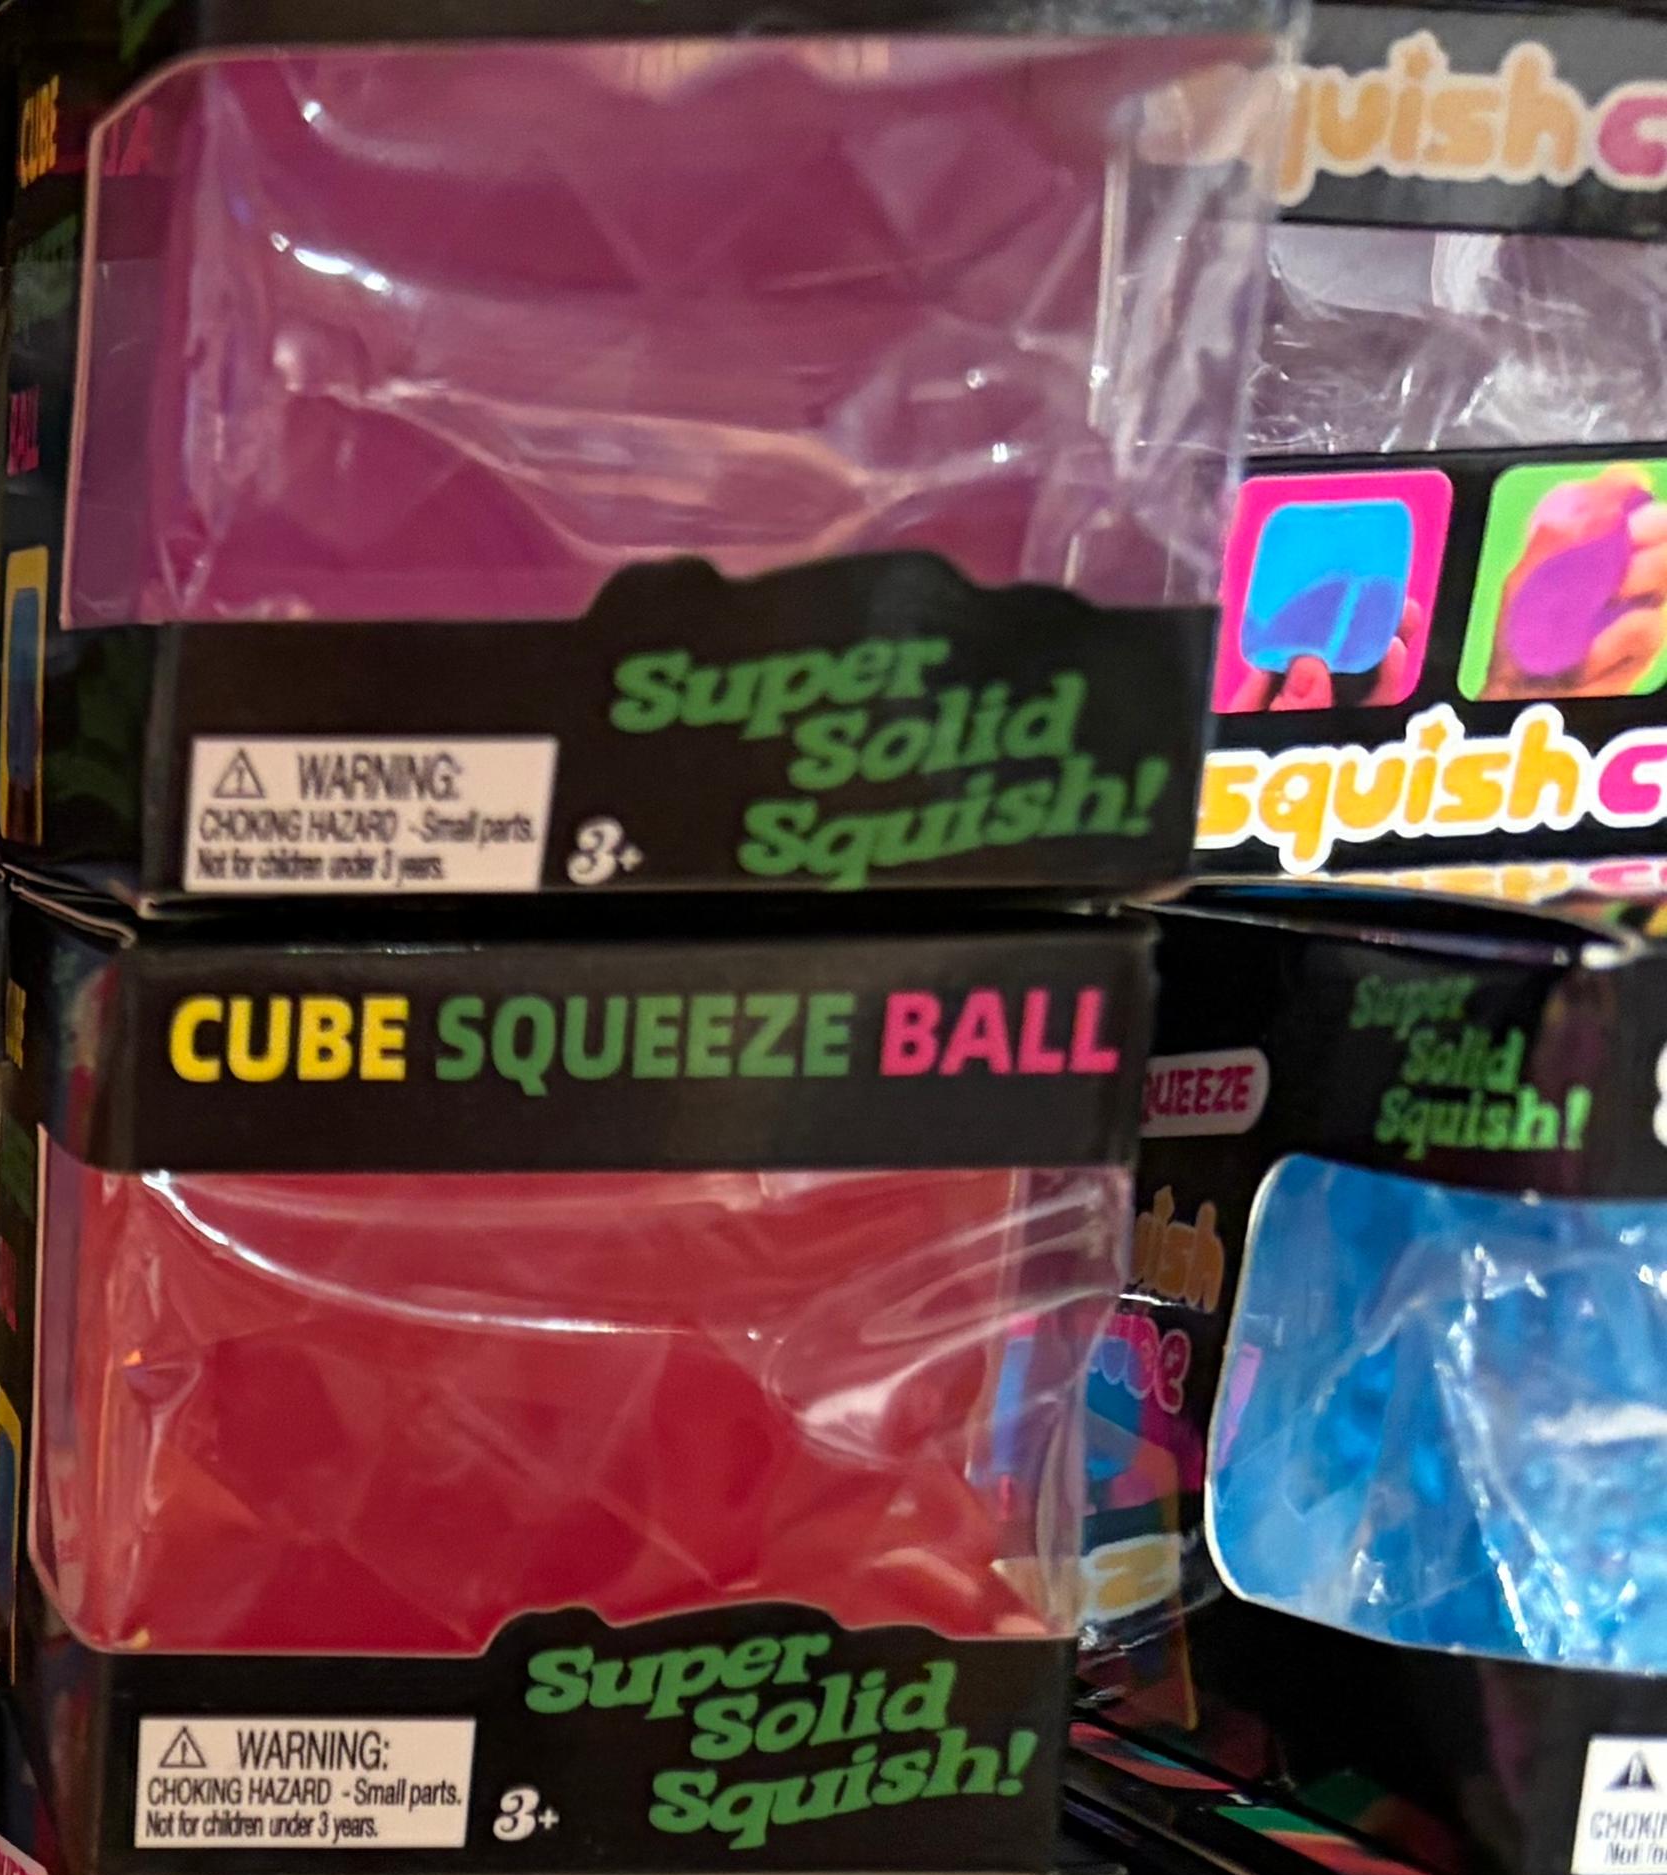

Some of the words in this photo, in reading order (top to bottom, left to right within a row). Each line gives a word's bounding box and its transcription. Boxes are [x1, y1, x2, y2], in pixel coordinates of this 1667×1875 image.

[168, 996, 410, 1085] CUBE
[436, 994, 858, 1097] SQUEEZE
[879, 990, 1121, 1079] BALL
[525, 1633, 830, 1718] Super
[692, 1661, 955, 1760] Solid
[648, 1730, 1038, 1849] Squish!
